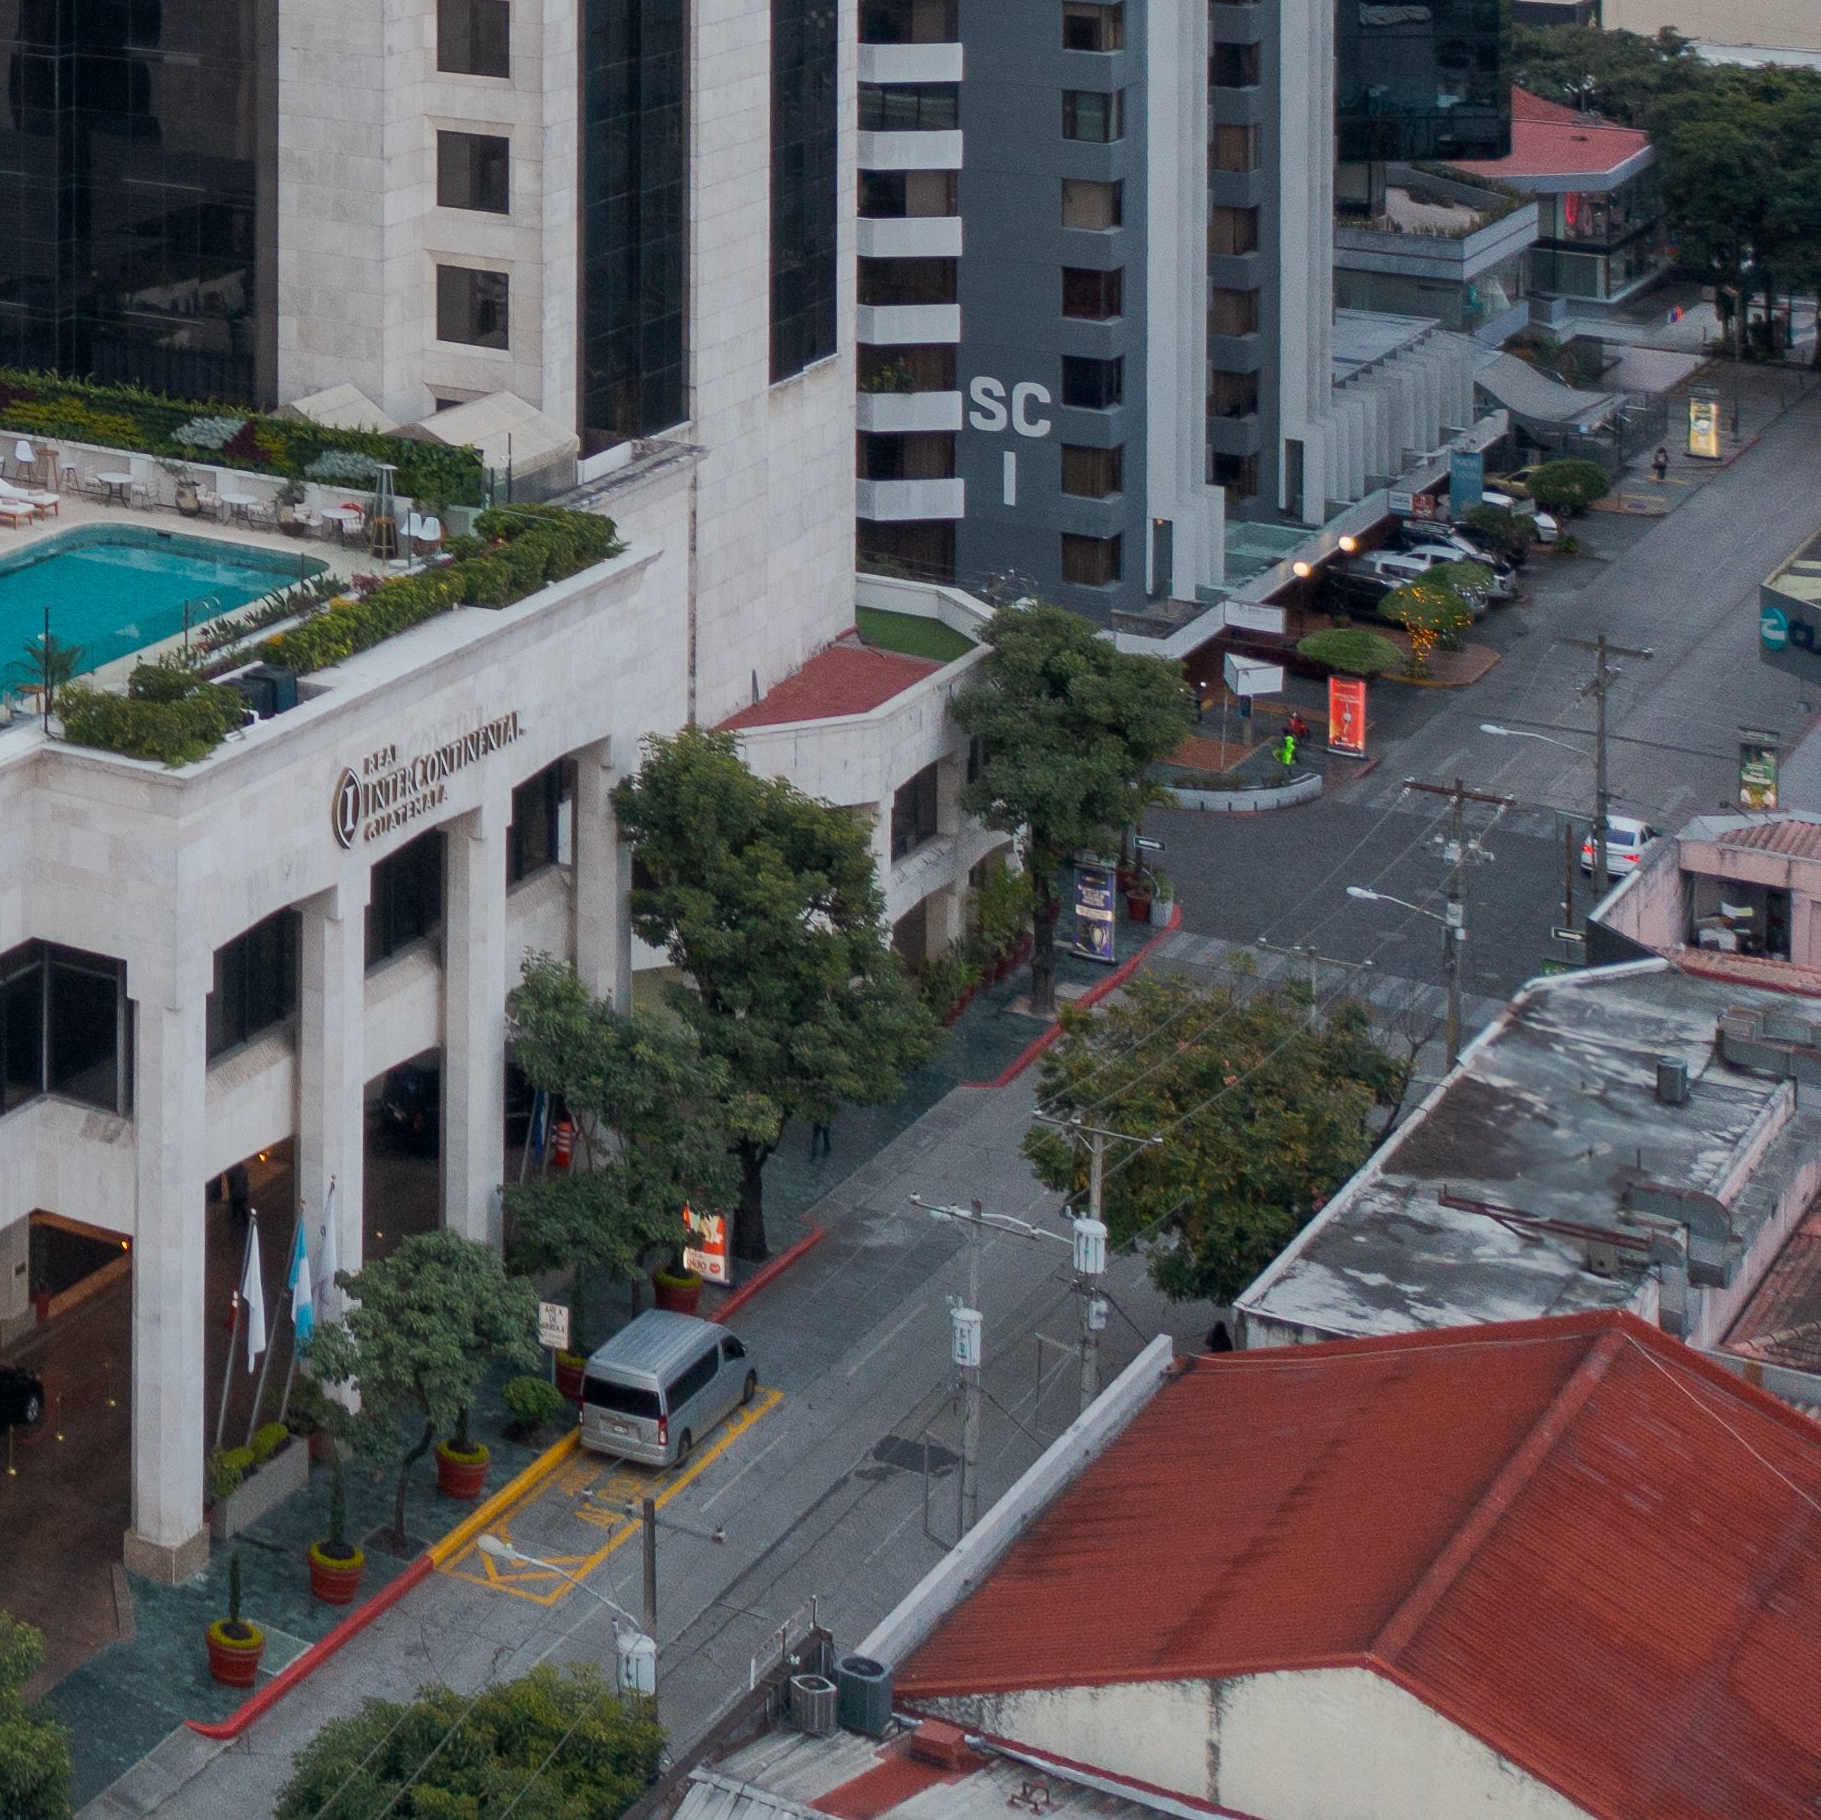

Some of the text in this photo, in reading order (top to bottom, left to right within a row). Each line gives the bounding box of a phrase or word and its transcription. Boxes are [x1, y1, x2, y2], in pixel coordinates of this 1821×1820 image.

[969, 376, 1052, 437] SC
[363, 711, 525, 818] INTERCONTINENTAL
[364, 744, 399, 775] REAL
[364, 784, 448, 841] GUATEMALA
